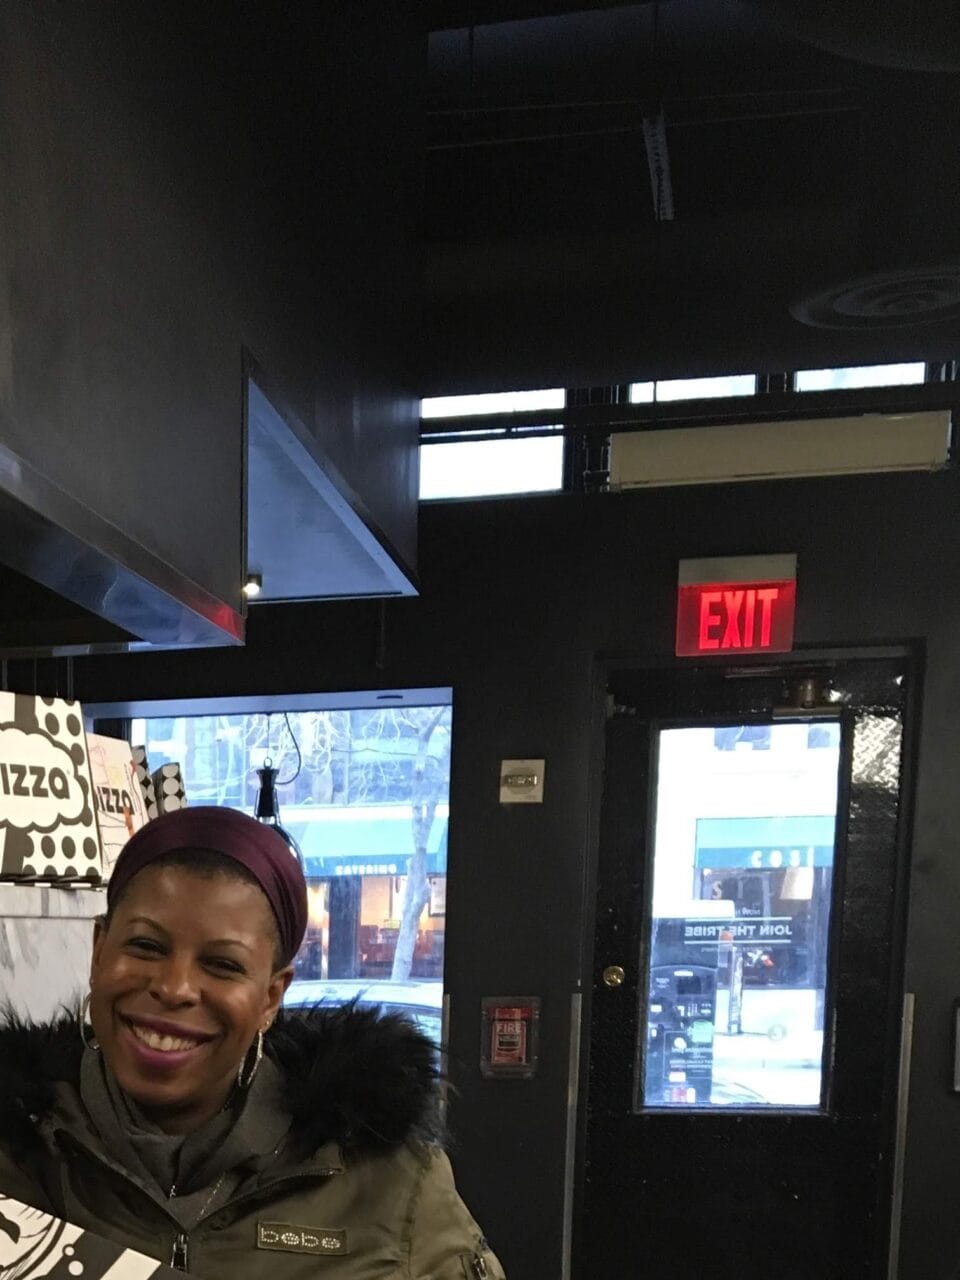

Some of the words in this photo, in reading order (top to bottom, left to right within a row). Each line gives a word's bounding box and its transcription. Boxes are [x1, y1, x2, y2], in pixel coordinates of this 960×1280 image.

[699, 588, 779, 650] EXIT
[97, 785, 135, 816] izza
[496, 1023, 522, 1033] FIRE
[261, 1227, 341, 1249] bebe
